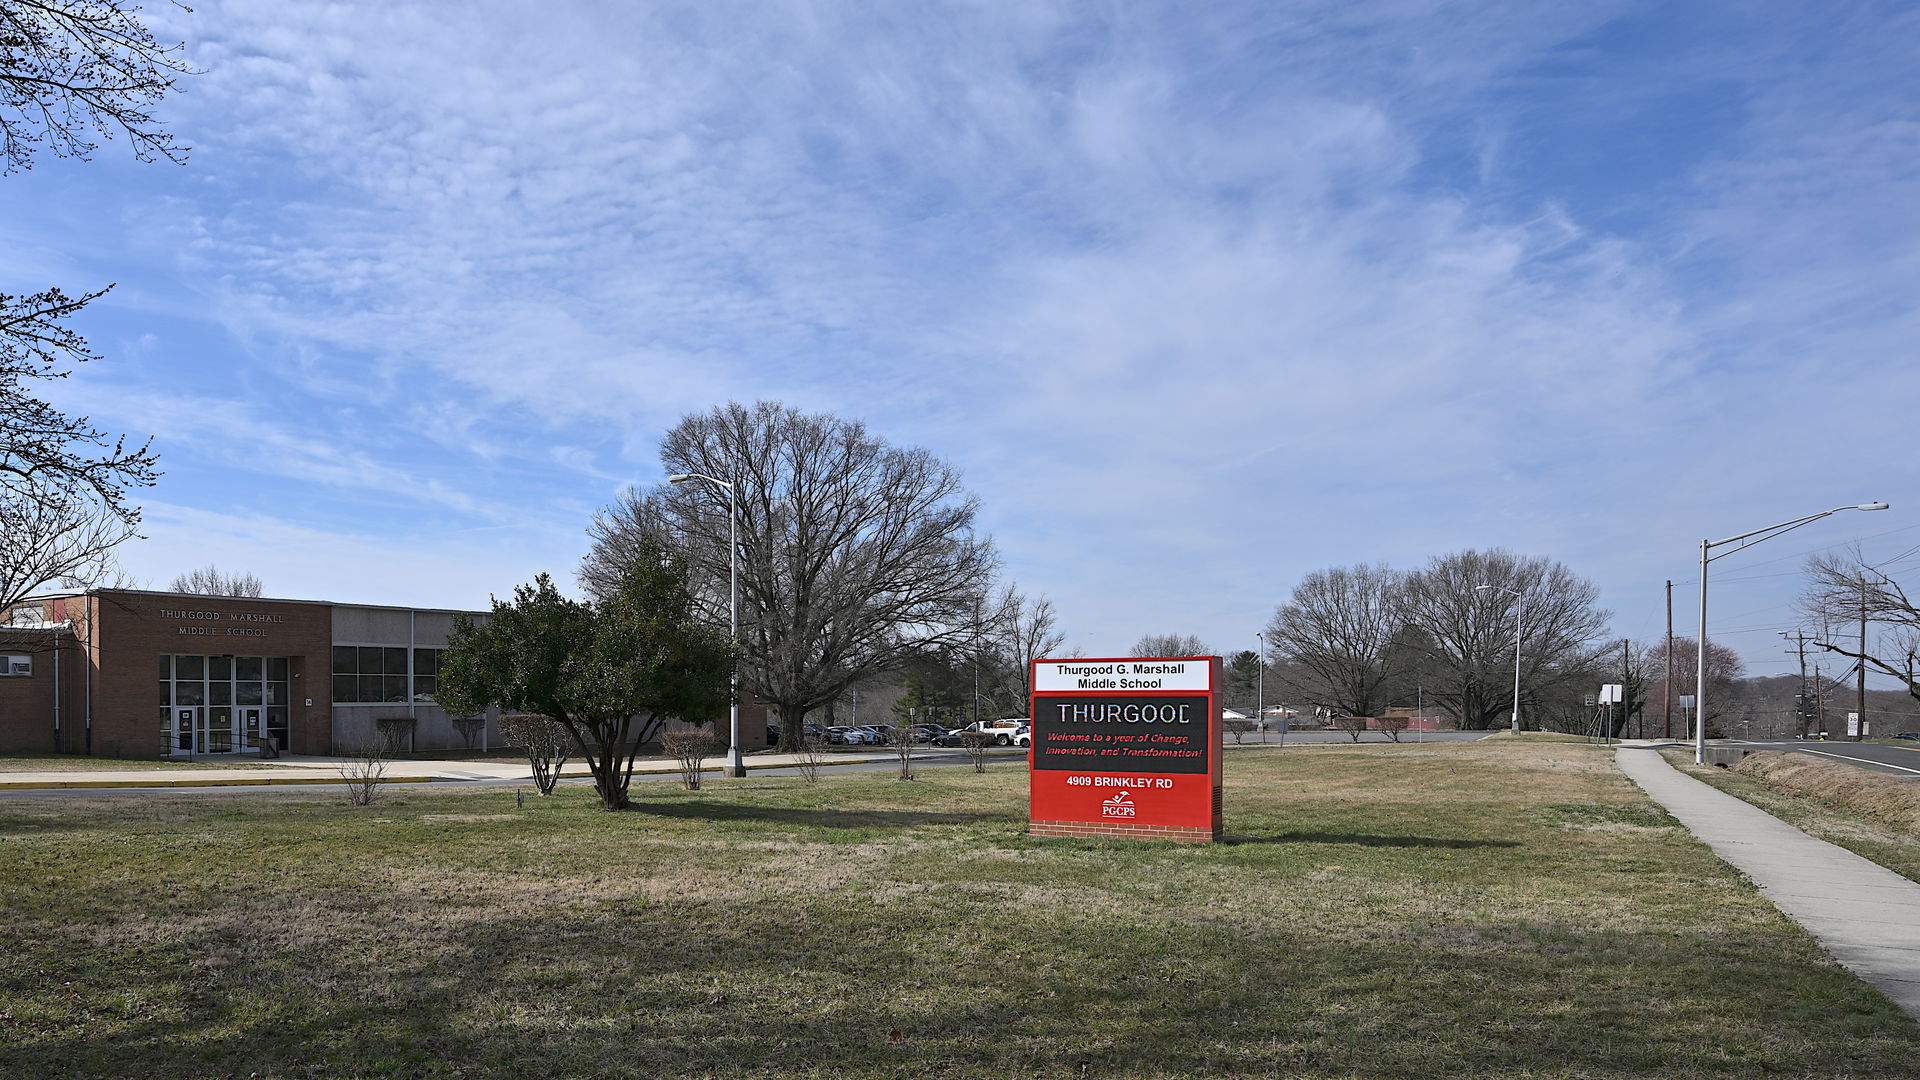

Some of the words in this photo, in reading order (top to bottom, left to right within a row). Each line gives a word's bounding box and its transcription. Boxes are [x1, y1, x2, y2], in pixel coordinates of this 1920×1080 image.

[160, 609, 220, 620] THURGOOD
[230, 613, 284, 623] MARSHALL
[179, 627, 217, 635] MIDDLE
[227, 628, 268, 637] SCHOOL
[1057, 664, 1113, 677] Thurgood
[1116, 664, 1129, 674] G.
[1133, 664, 1185, 674] Marshall
[1078, 678, 1117, 688] Middle
[1119, 678, 1162, 688] School
[1047, 732, 1091, 742] Welcome
[1093, 733, 1103, 742] to
[1113, 735, 1135, 744] year
[1137, 733, 1150, 742] of
[1151, 733, 1190, 745] Change,
[1045, 746, 1098, 757] Innovation,
[1101, 747, 1121, 756] and
[1122, 747, 1203, 757] Transformation!
[1066, 776, 1092, 786] 4909
[1094, 776, 1153, 788] BRINKLEY
[1155, 778, 1173, 788] RD
[1102, 806, 1136, 816] PGCPS
